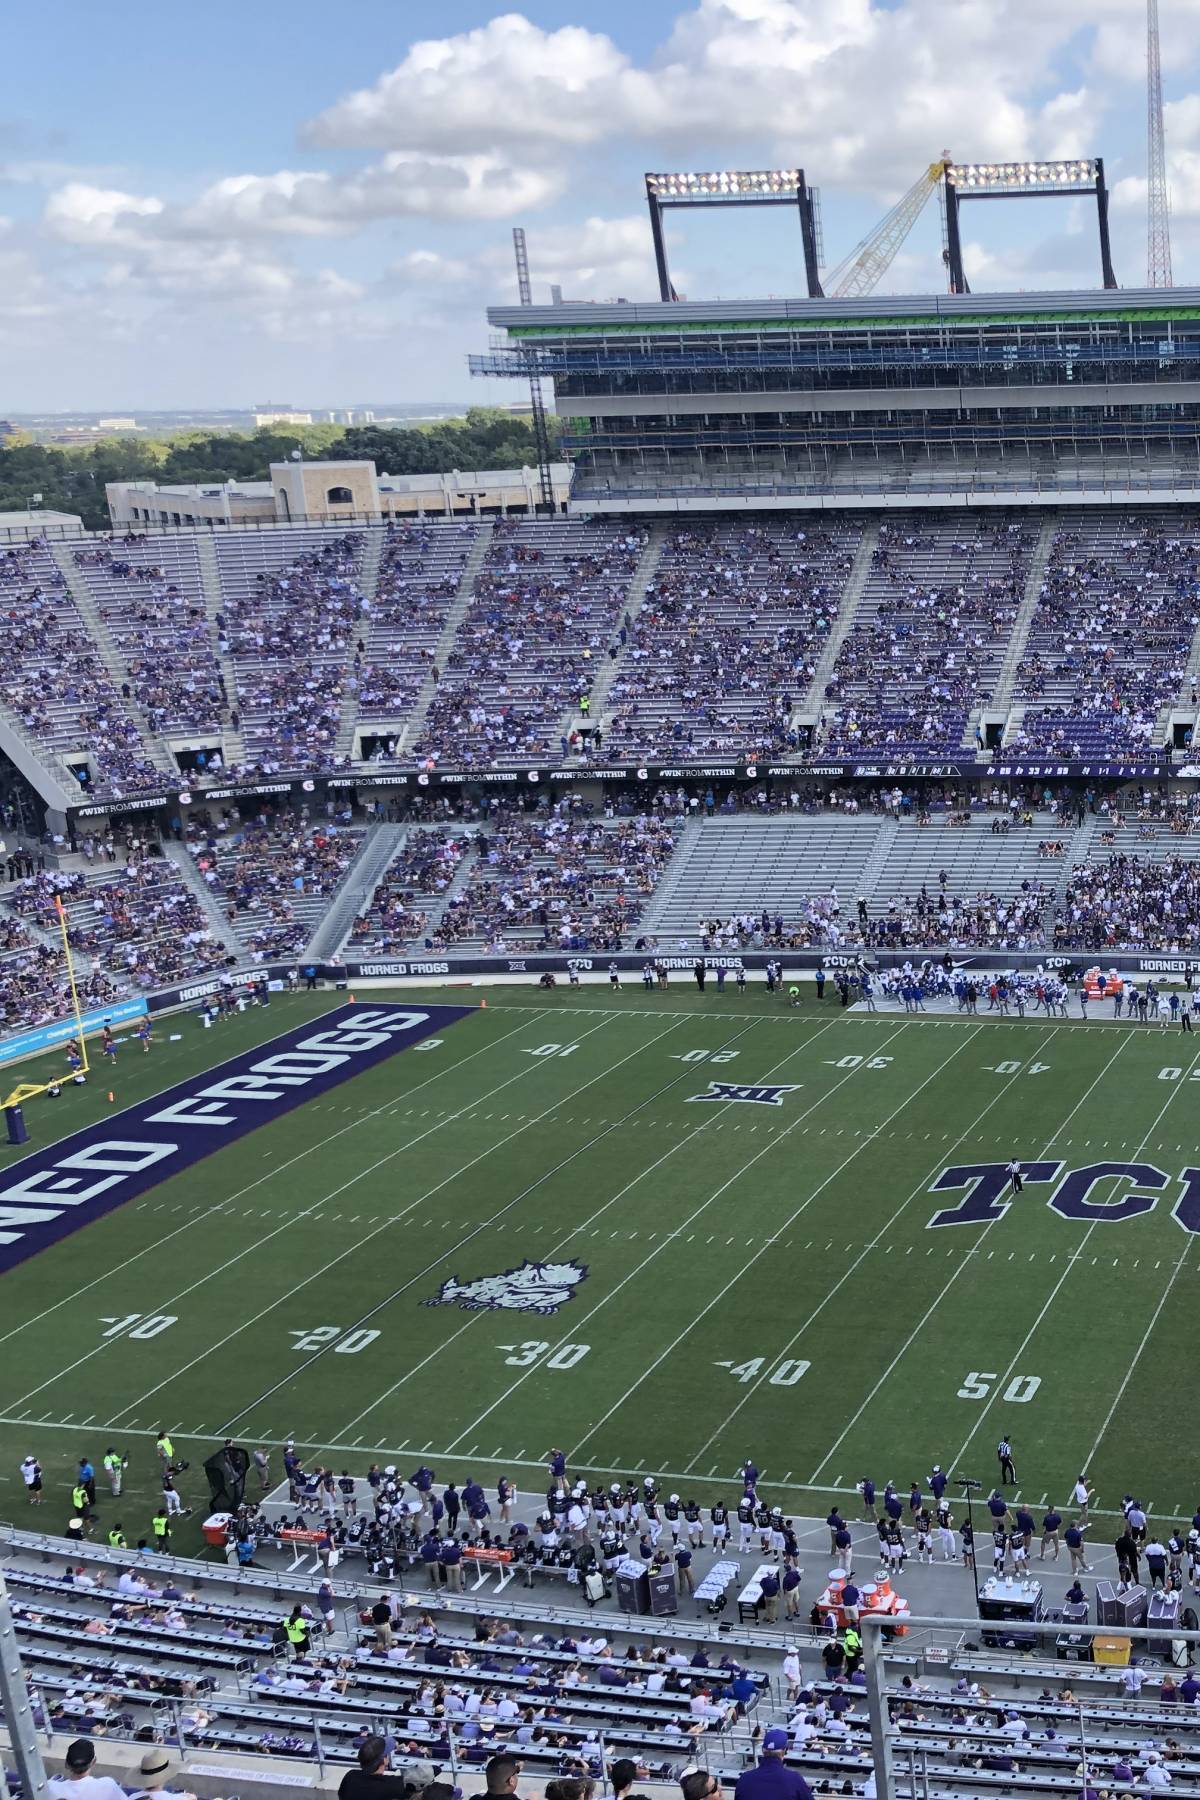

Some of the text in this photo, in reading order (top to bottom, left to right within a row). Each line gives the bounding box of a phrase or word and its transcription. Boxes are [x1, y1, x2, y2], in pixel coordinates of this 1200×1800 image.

[440, 773, 518, 784] #WINFROMWITHIN
[550, 770, 627, 780] #WINFROMWITHIN
[659, 768, 736, 778] #WINFROMWITHIN
[768, 767, 844, 776] #WINFROMWITHIN
[328, 776, 408, 788] #WINFROMWITHIN
[205, 784, 292, 800] #WINFROMWITHIN
[78, 797, 168, 817] #WINFROMWITHIN
[705, 957, 743, 969] FROGS
[822, 956, 848, 967] TCU
[1140, 959, 1185, 972] HORNED
[360, 962, 449, 976] HORNED FROGS
[143, 1010, 431, 1126] FROGS
[102, 1313, 178, 1339] 10
[291, 1326, 381, 1354] 20
[505, 1340, 591, 1369] 30
[729, 1357, 811, 1386] 40
[957, 1372, 1042, 1403] 50
